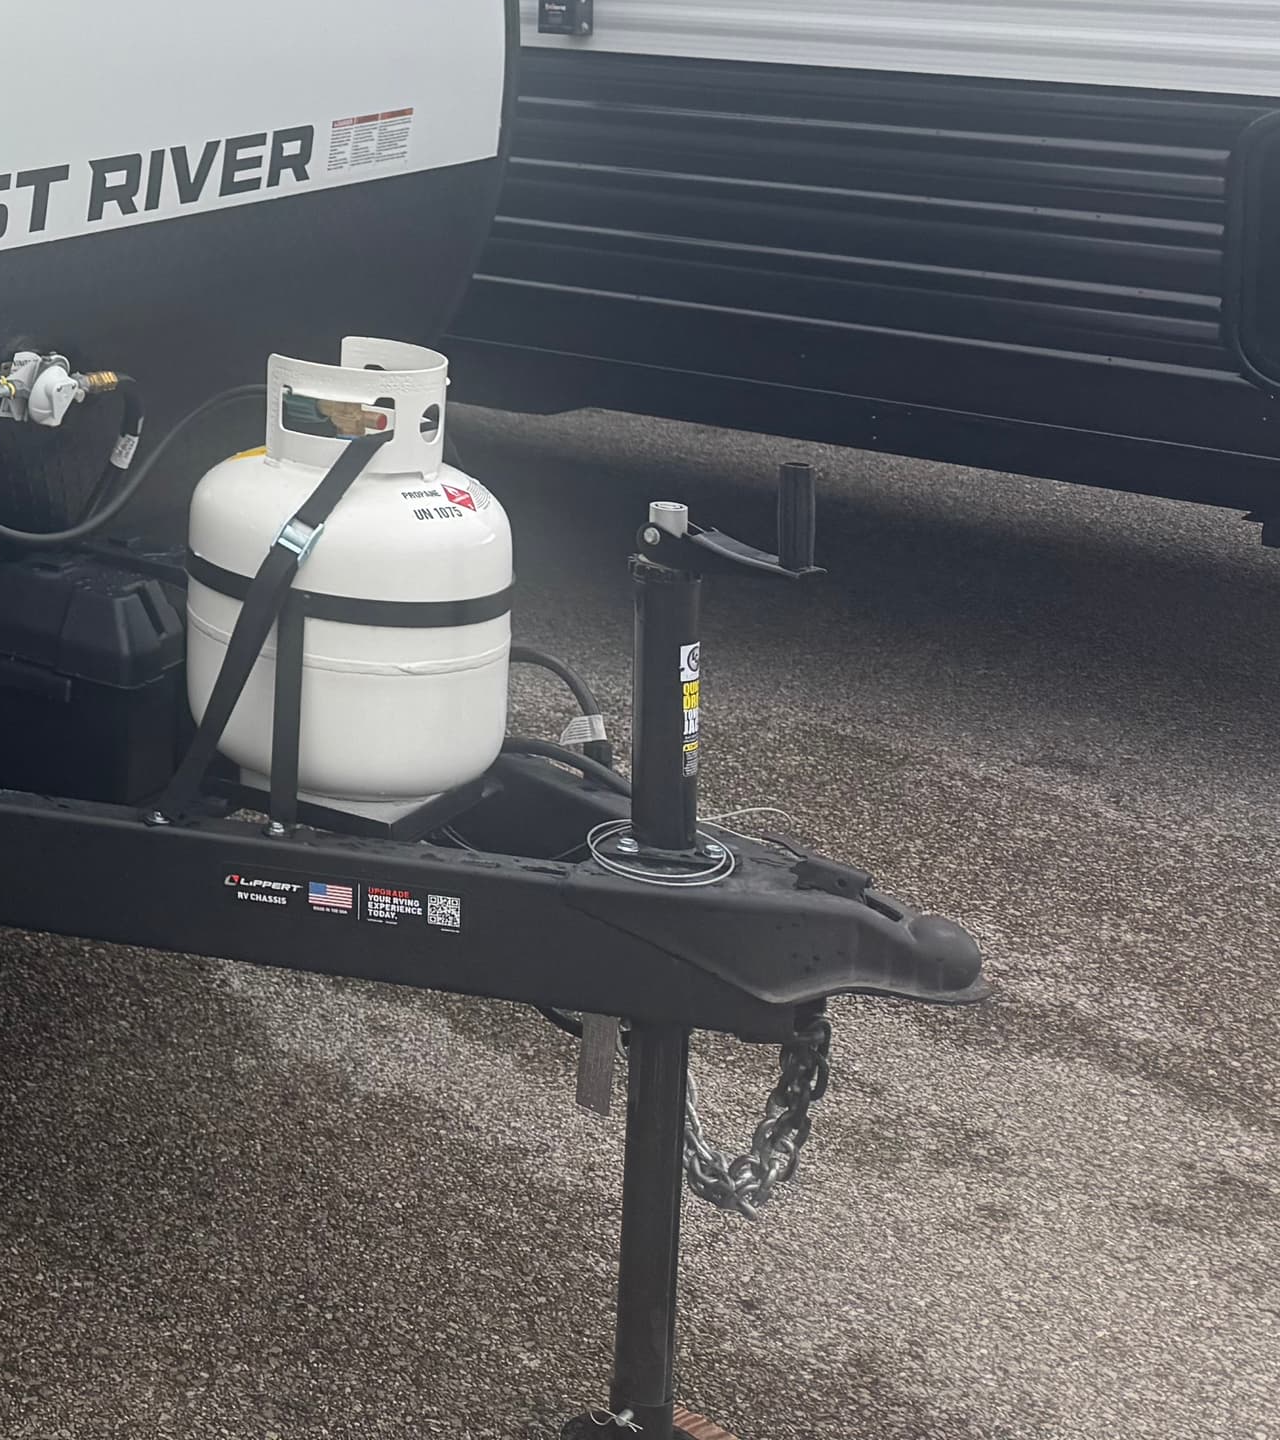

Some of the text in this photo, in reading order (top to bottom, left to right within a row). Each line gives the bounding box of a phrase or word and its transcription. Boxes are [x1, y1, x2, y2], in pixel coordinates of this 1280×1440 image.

[88, 124, 315, 222] RIVER
[401, 489, 441, 499] PROPANE
[413, 506, 463, 520] UN 1075
[237, 891, 287, 905] RV CHASSIS
[368, 894, 420, 907] YOUR RVING
[367, 901, 423, 916] EXPERIENCE
[367, 908, 398, 920] TODAY.
